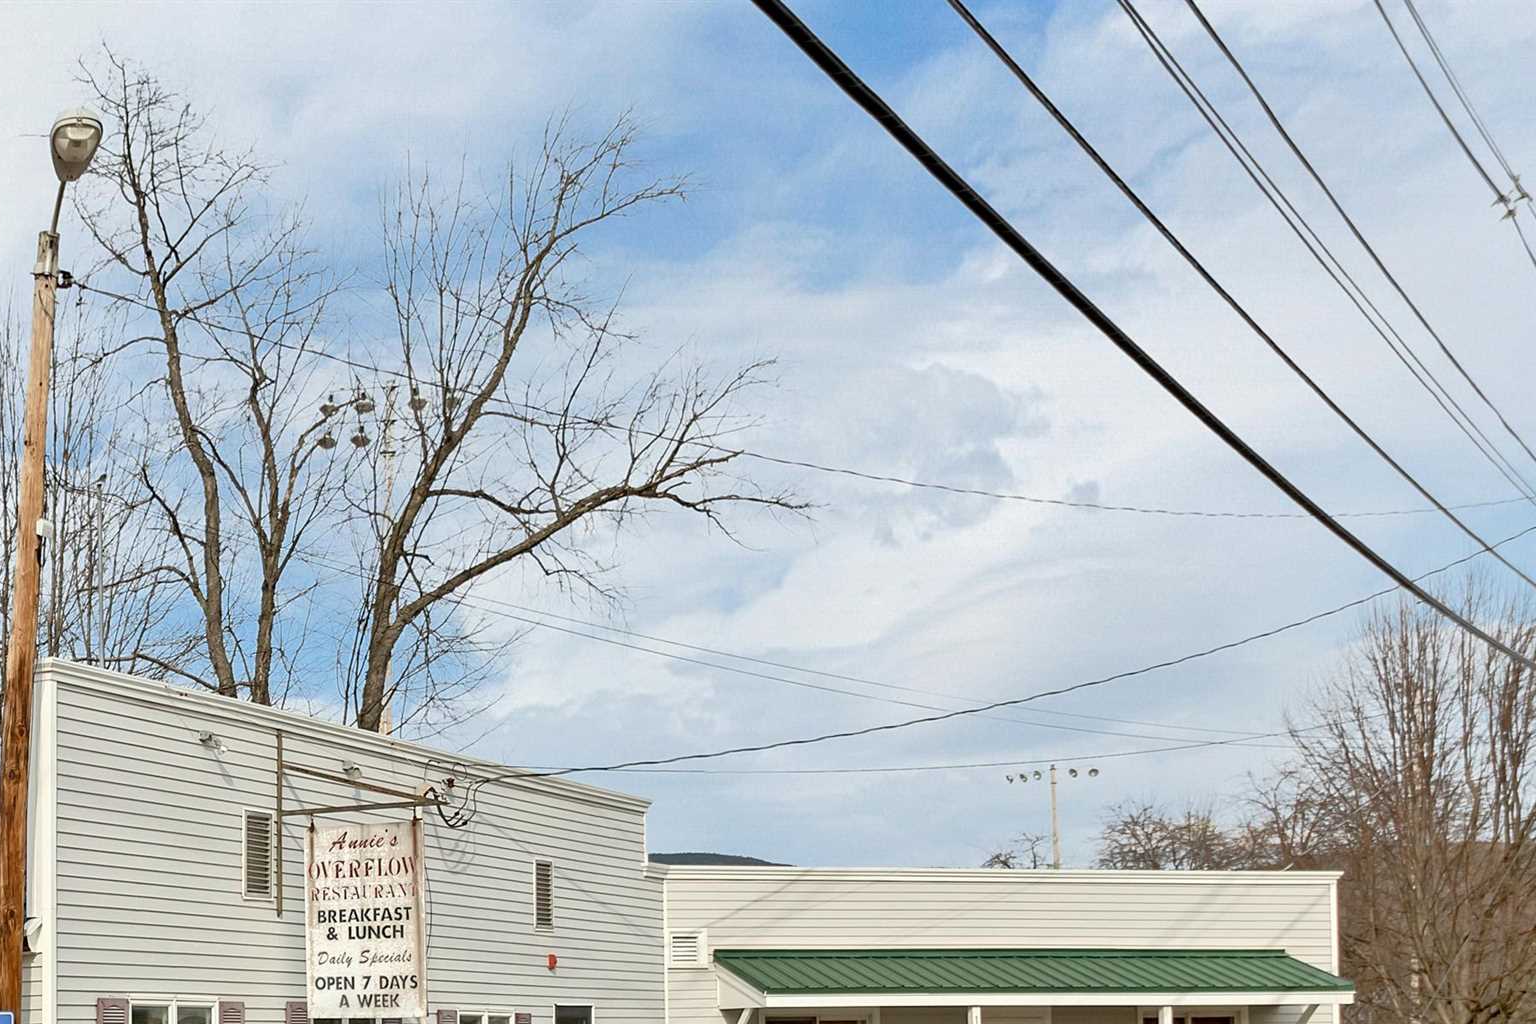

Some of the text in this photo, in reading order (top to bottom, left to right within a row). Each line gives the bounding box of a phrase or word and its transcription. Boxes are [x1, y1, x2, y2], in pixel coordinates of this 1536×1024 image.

[329, 829, 398, 852] Annie's
[308, 856, 418, 879] OVERFLOW
[311, 883, 417, 901] RESTAURANT
[317, 907, 412, 923] BREAKFAST
[326, 925, 404, 940] & LUNCH
[317, 949, 412, 968] Daily Specials
[315, 975, 418, 990] OPEN 7 DAYS
[339, 994, 400, 1008] A WEEK
